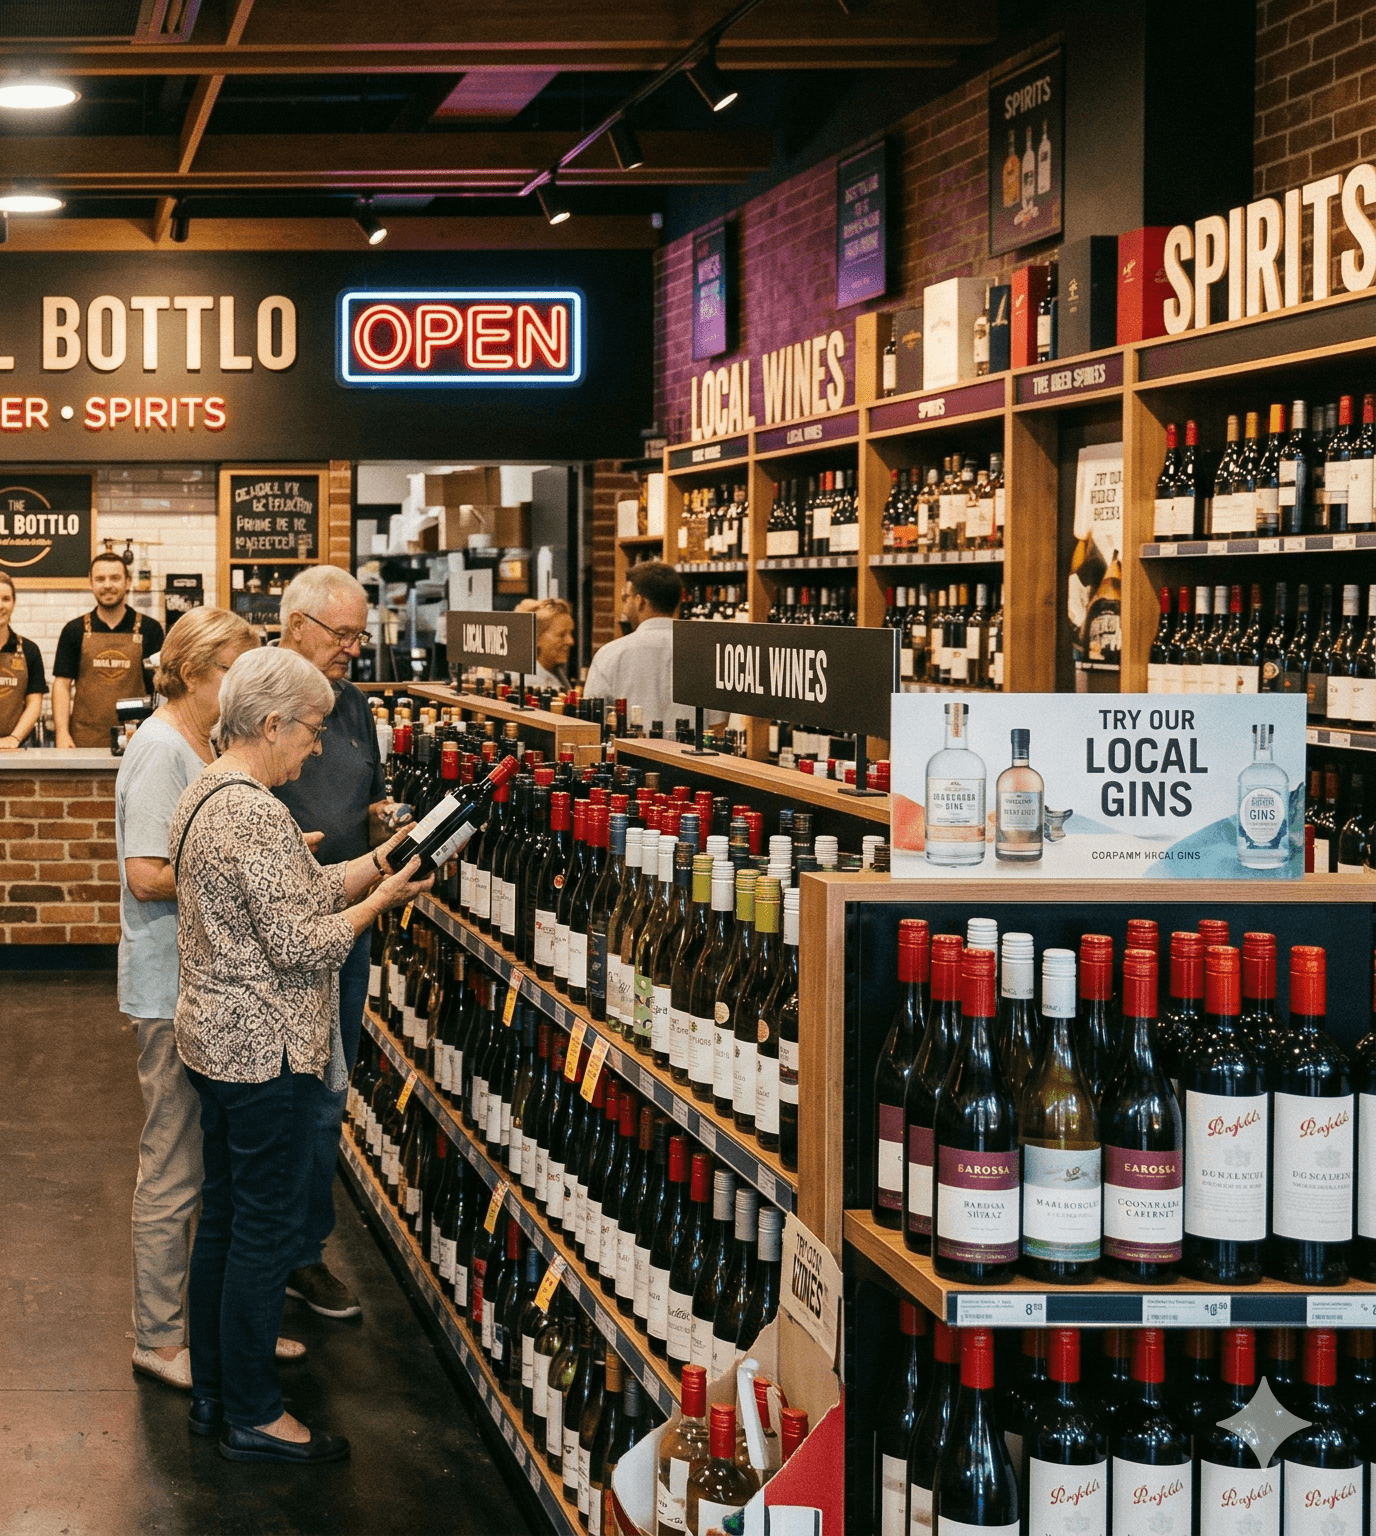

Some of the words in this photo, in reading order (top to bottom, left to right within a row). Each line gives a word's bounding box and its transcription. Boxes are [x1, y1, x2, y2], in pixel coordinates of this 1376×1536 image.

[1004, 76, 1051, 120] SPIRITS
[1163, 163, 1376, 336] SPIRITS
[43, 295, 297, 371] BOTTLO
[353, 304, 567, 370] OPEN
[691, 358, 756, 442] LOCAL
[762, 330, 845, 425] WINES
[83, 396, 227, 430] SPIRITS
[13, 514, 80, 535] BOTTLO
[715, 643, 764, 694] LOCAL
[768, 647, 828, 703] WINES
[1098, 709, 1142, 730] TRY
[1149, 709, 1195, 730] OUR
[1086, 737, 1208, 774] LOCAL
[1101, 780, 1193, 818] GINS
[1249, 809, 1276, 820] GINS
[1177, 851, 1201, 860] GINS
[792, 1253, 824, 1320] WINES
